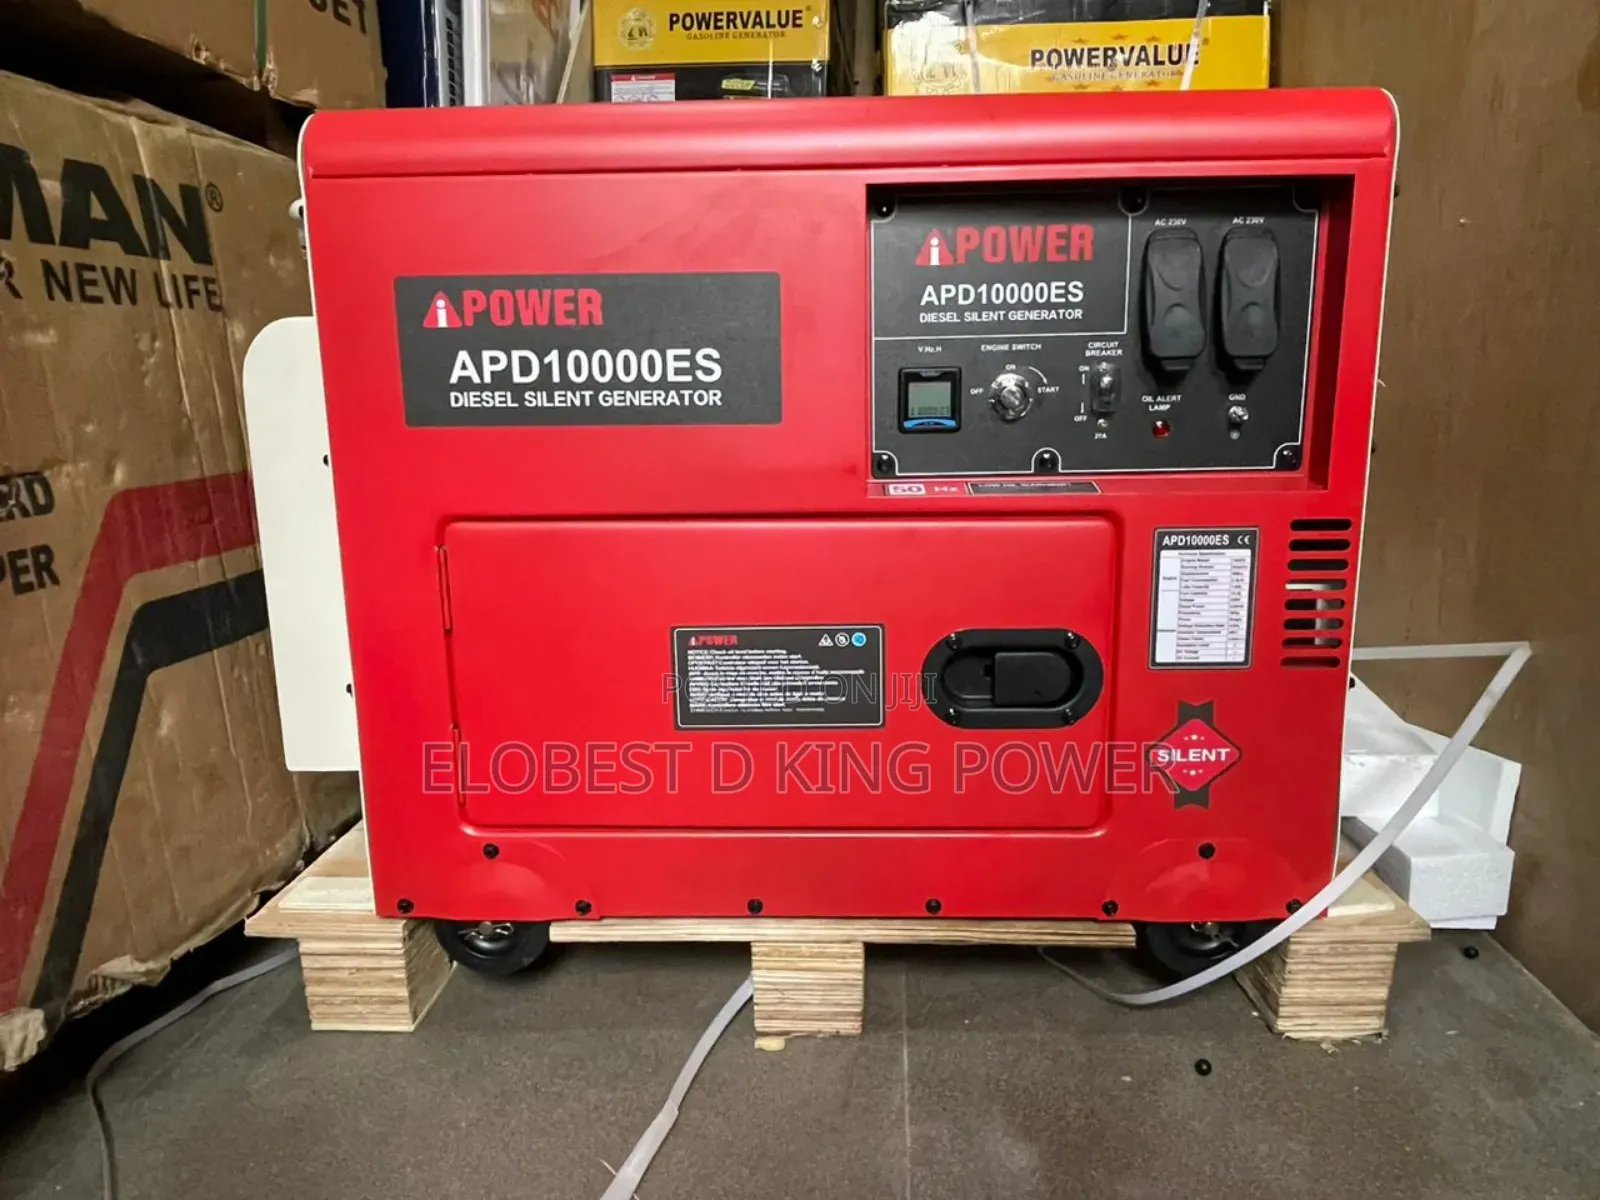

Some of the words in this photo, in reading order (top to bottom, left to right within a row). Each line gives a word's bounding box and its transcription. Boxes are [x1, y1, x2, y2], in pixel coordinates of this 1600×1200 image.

[669, 9, 804, 32] POWERVALUE
[40, 258, 138, 306] NEW
[153, 272, 226, 313] LIFE
[920, 281, 1085, 306] APD10000ES
[919, 311, 961, 324] DIESEL
[963, 310, 1006, 322] SILENT
[1008, 308, 1084, 321] GENERATOR
[981, 344, 1009, 352] ENGINE
[1011, 343, 1042, 351] SWITCH
[1087, 341, 1120, 349] CIRCUIT
[1084, 348, 1124, 357] BREAKER
[450, 347, 723, 384] APD10000ES
[1037, 386, 1060, 394] START
[450, 392, 518, 408] DIESEL
[524, 391, 593, 407] SILENT
[599, 390, 722, 408] GENERATOR
[1155, 394, 1182, 403] ALERT
[1148, 404, 1170, 412] LAMP
[1073, 414, 1088, 422] OFF
[1162, 535, 1230, 546] APD10000ES
[1157, 748, 1230, 762] SILENT
